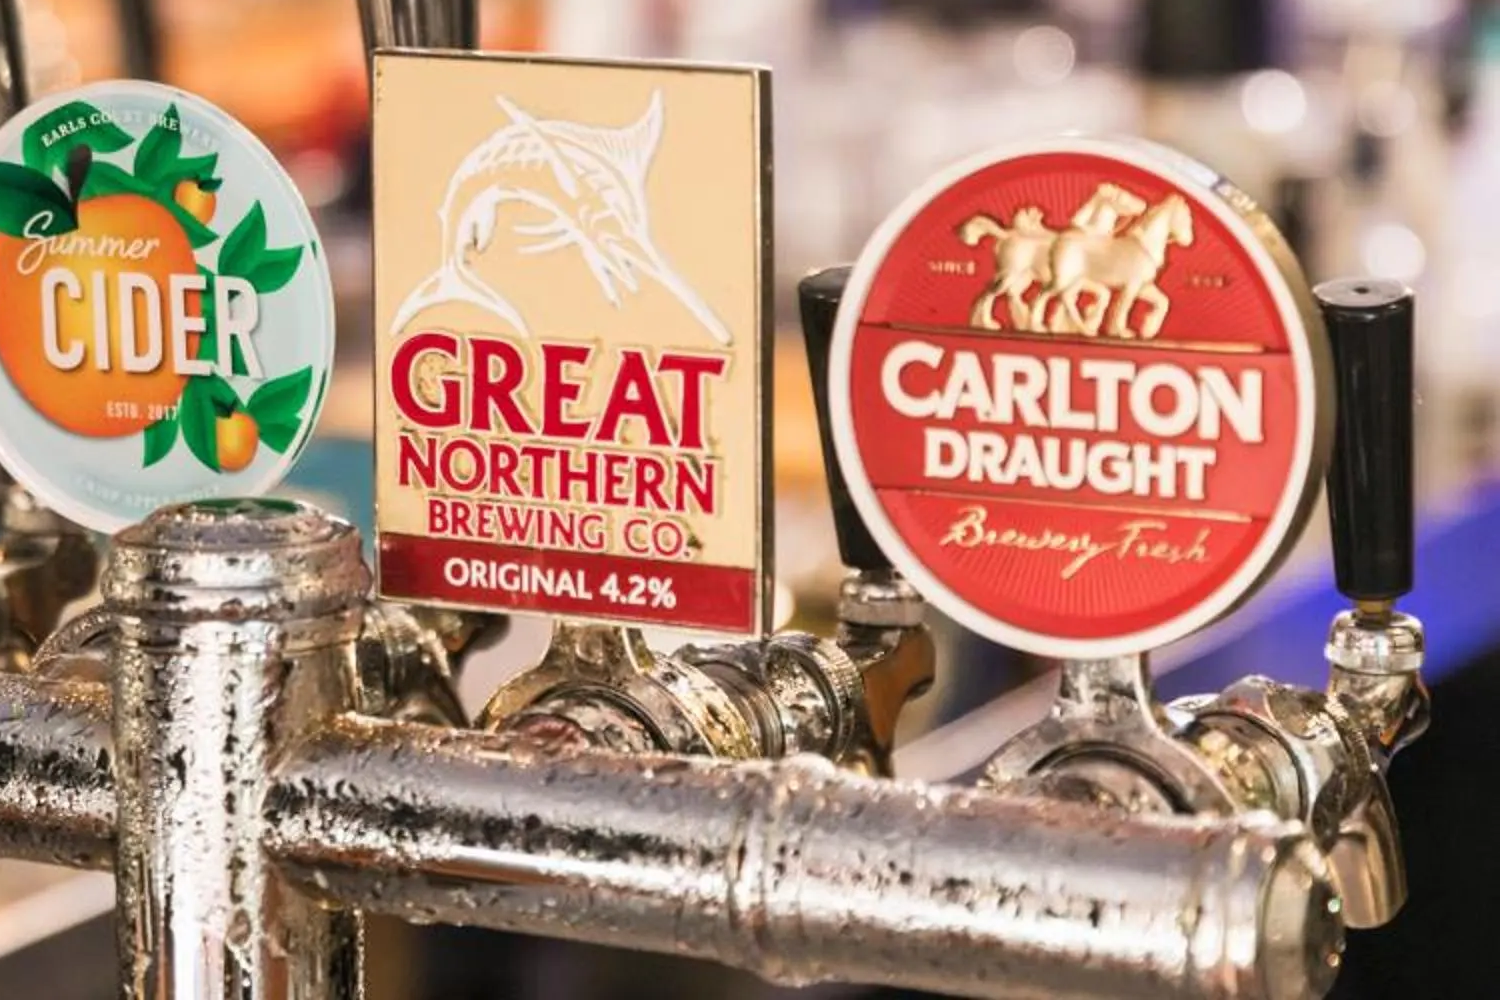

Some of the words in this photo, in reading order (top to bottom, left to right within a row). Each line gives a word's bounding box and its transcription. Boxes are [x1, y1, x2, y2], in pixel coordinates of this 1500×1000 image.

[41, 117, 87, 147] EARLS
[17, 210, 160, 275] Summer
[41, 267, 266, 378] CIDER
[147, 405, 177, 421] 2017
[390, 332, 726, 449] GREAT
[881, 341, 1263, 443] CARLTON
[398, 435, 715, 514] NORTHERN
[924, 427, 1216, 500] DRAUGHT
[428, 499, 604, 552] BREWING
[622, 518, 692, 557] CO.
[939, 505, 1117, 581] Brewery
[1116, 519, 1211, 563] Fresh
[444, 558, 592, 600] ORIGINAL
[601, 573, 677, 609] 4.2%
